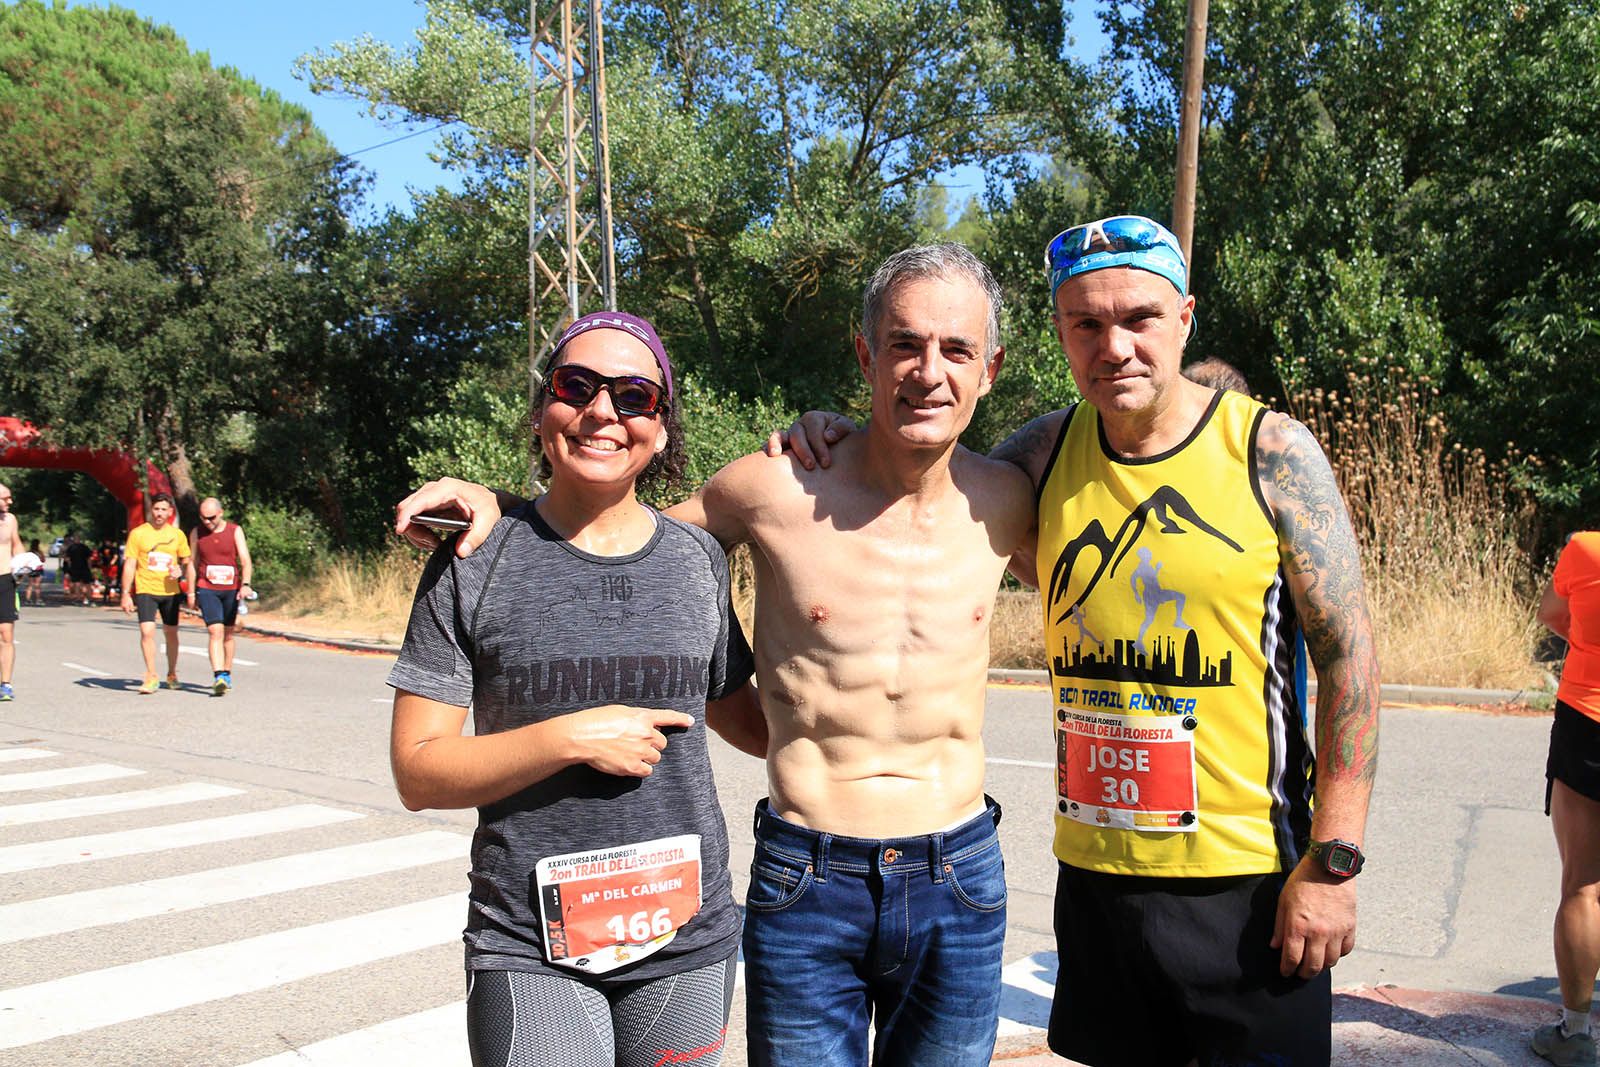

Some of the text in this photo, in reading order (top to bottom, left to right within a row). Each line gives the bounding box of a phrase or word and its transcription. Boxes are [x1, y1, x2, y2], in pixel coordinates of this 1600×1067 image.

[1082, 689, 1124, 709] TRAIL
[1129, 693, 1197, 716] RUNNER
[1061, 721, 1174, 740] 2on TRAIL DE LA FLORESTA
[1072, 713, 1085, 721] CURSA
[1098, 717, 1122, 727] FLORESTA
[1087, 744, 1150, 773] JOSE
[1101, 776, 1140, 805] 30
[547, 848, 637, 869] XXXIV CURSA DE LA FLORESTA
[549, 869, 572, 881] 2on
[574, 861, 609, 878] TRAIL
[608, 859, 623, 872] DE
[624, 857, 638, 870] LA
[603, 888, 629, 901] DEL
[631, 877, 683, 897] CARMEN
[606, 907, 673, 942] 166
